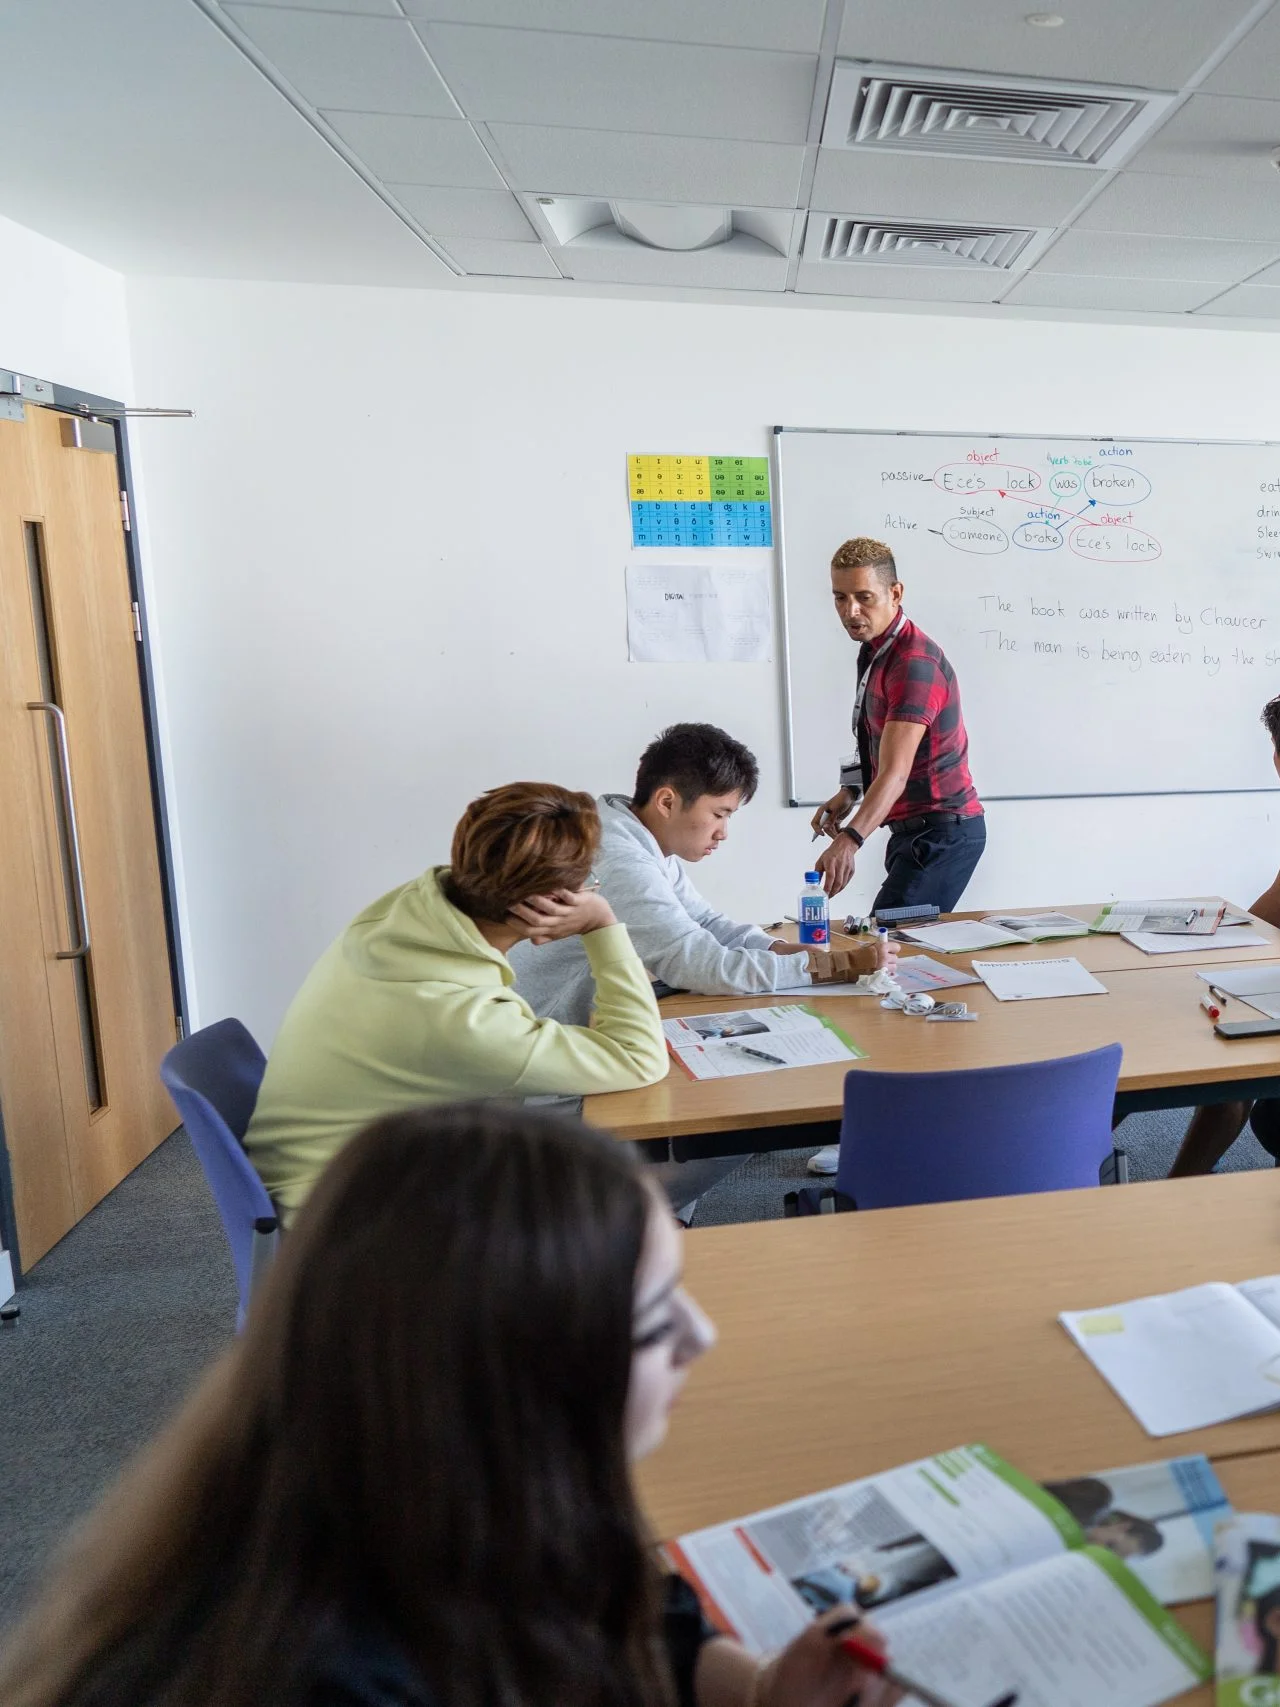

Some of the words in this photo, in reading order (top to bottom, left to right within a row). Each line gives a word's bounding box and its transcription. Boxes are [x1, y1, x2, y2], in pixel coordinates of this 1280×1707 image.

[966, 448, 999, 463] object
[1098, 446, 1133, 457] action
[881, 471, 924, 485] passive
[943, 473, 985, 491] Ece's
[1006, 471, 1035, 490] lock
[1054, 477, 1078, 490] was
[1092, 471, 1135, 488] broken
[884, 513, 919, 531] Active
[1027, 509, 1061, 521] action
[1100, 512, 1134, 525] object
[1023, 530, 1059, 545] broke
[1075, 528, 1111, 550] Ece's
[1125, 539, 1159, 552] lock
[978, 595, 1014, 614] The
[1029, 597, 1066, 618] book
[1079, 606, 1110, 620] was
[1117, 605, 1159, 623] written
[1174, 603, 1194, 635] by
[1200, 607, 1268, 631] Chaucer
[979, 629, 1018, 653] The
[1033, 641, 1063, 654] man
[1076, 641, 1090, 660] is
[1101, 638, 1142, 673] being
[1149, 648, 1192, 665] eaten
[1203, 645, 1221, 677] by
[1231, 648, 1255, 666] the
[805, 906, 826, 921] FIJI
